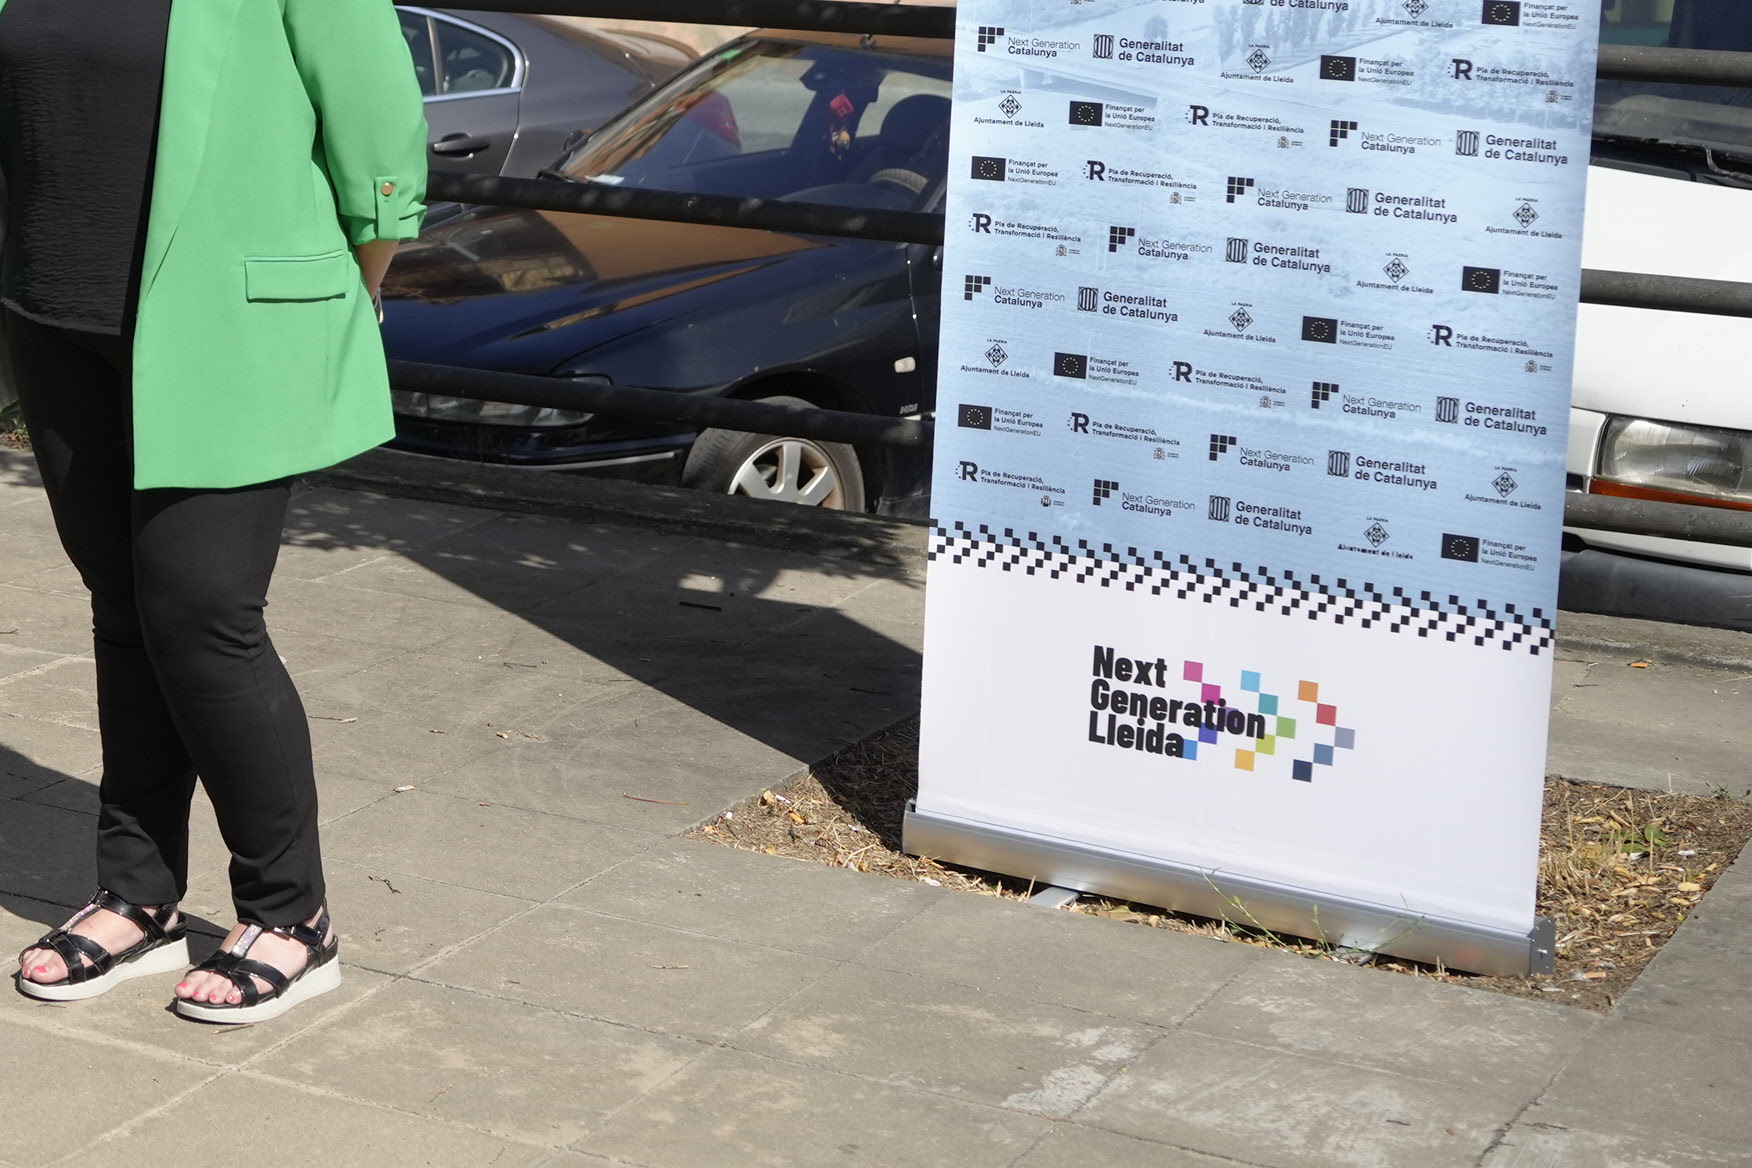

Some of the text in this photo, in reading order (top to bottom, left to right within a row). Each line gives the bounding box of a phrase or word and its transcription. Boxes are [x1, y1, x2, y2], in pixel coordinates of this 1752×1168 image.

[1375, 17, 1418, 26] Ajuntament
[1431, 20, 1453, 28] Lleida
[1008, 37, 1080, 49] Next Generation
[1008, 43, 1057, 58] Catalunya
[973, 117, 1013, 125] Ajuntament
[1485, 134, 1556, 150] Generalitat
[1484, 148, 1567, 166] de Catalunya
[1108, 175, 1154, 185] Transformació
[1160, 180, 1196, 189] Resiliència
[1130, 170, 1173, 180] Recuperació,
[1257, 188, 1332, 203] Next Generation
[1257, 195, 1308, 211] Catalunya
[1375, 192, 1445, 208] Generalitat
[1374, 205, 1457, 224] de Catalunya
[1503, 270, 1534, 280] Finançat
[1356, 280, 1398, 290] Ajuntament
[1511, 279, 1527, 287] Unió
[1529, 281, 1558, 290] Europea
[994, 286, 1065, 301] Next Generation
[994, 293, 1042, 308] Catalunya
[1103, 291, 1166, 307] Generalitat
[1102, 304, 1177, 323] de Catalunya
[960, 365, 999, 374] Ajuntament
[1010, 370, 1029, 378] Lleida
[1465, 402, 1535, 420] Generalitat
[1464, 415, 1546, 436] de Catalunya
[1239, 455, 1289, 471] Catalunya
[1240, 447, 1314, 464] Next Generation
[1236, 501, 1301, 520] Generalitat
[1234, 514, 1311, 535] de Catalunya
[1092, 645, 1168, 688] Next
[1090, 678, 1265, 740] Generation
[1088, 710, 1184, 759] Lleida
